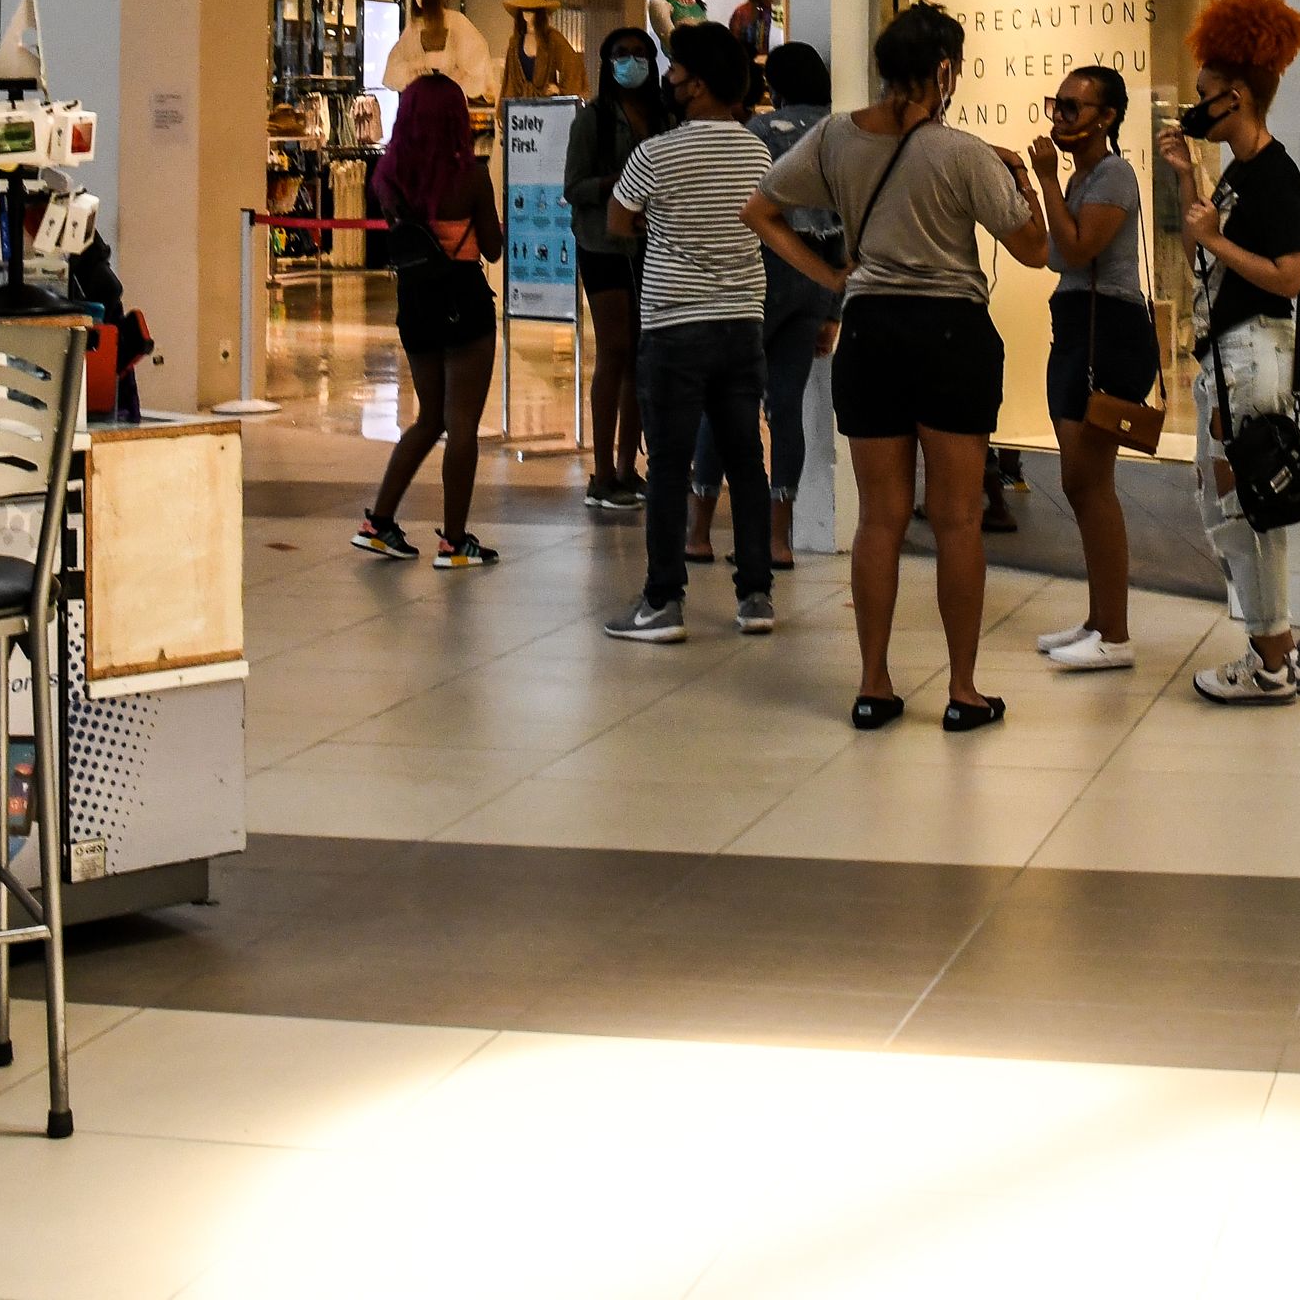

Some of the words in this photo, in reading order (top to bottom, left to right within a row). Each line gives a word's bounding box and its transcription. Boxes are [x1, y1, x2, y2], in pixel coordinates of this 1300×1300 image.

[956, 0, 1158, 33] PRECAUTIONS
[1005, 53, 1074, 78] KEEP
[510, 114, 544, 134] Safety
[957, 102, 1008, 126] AND
[510, 137, 538, 153] First.
